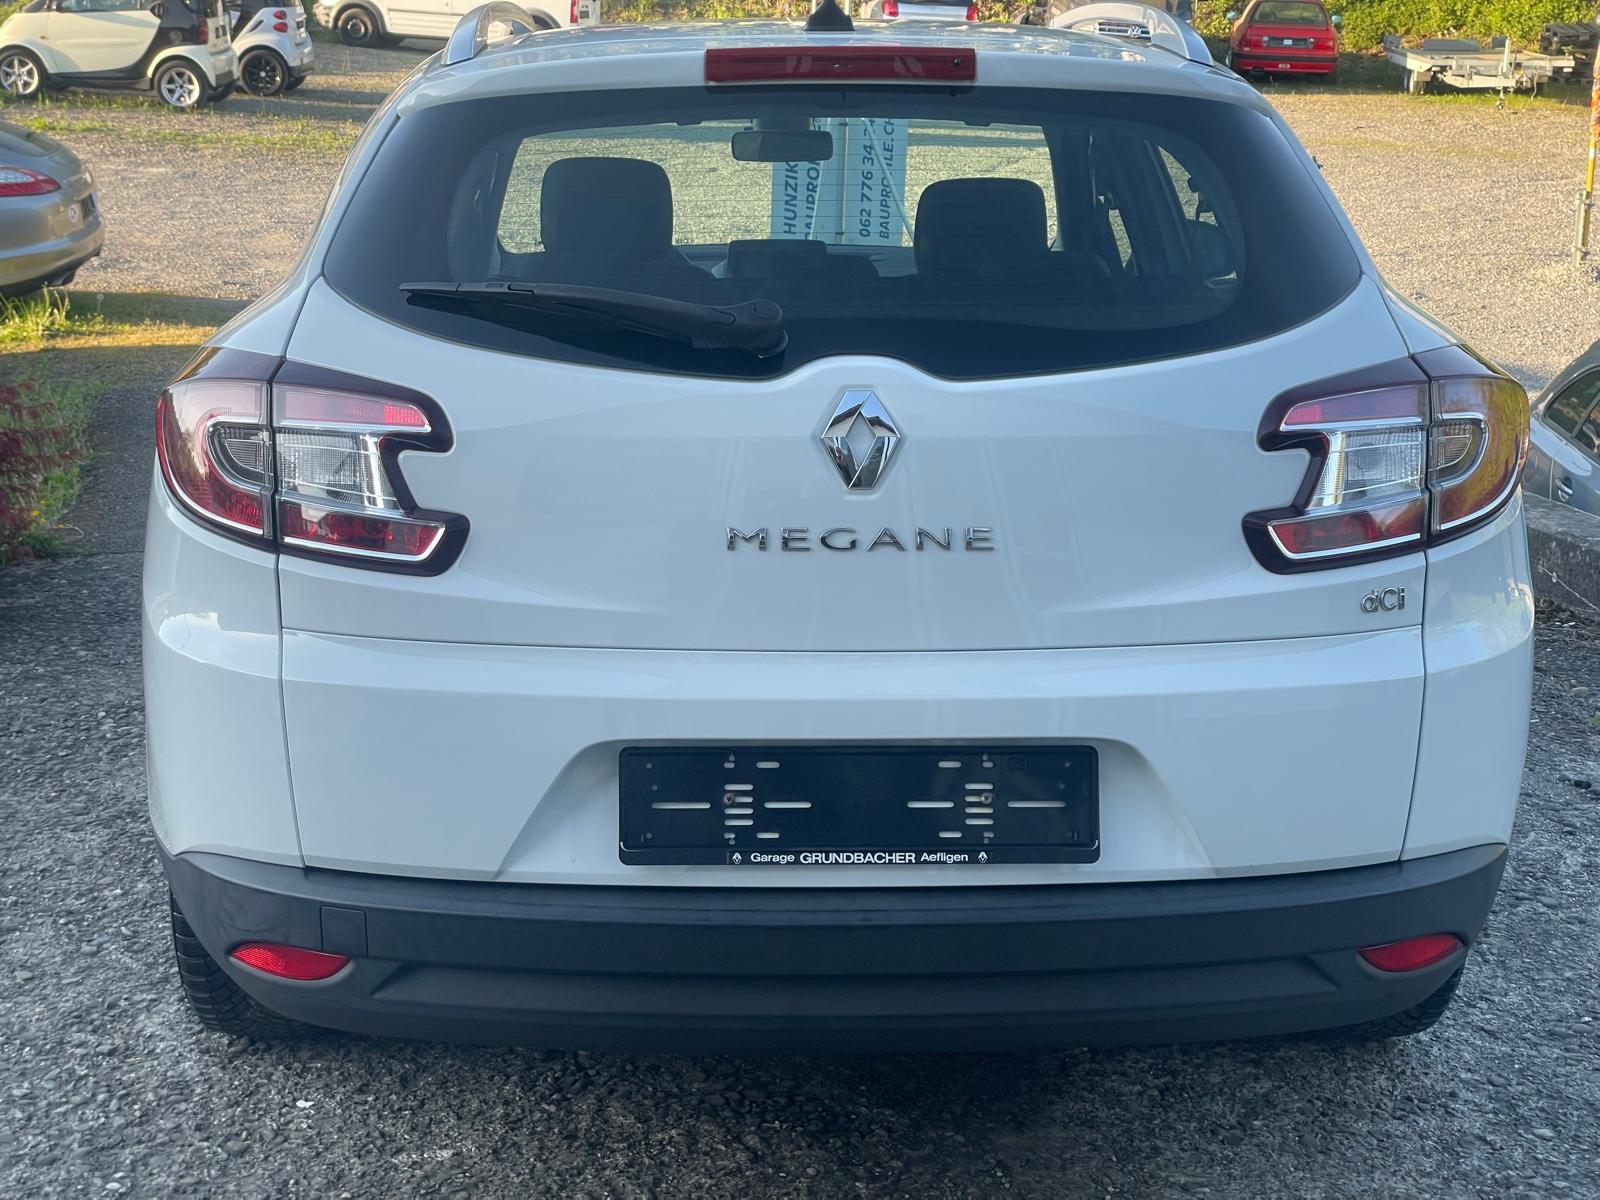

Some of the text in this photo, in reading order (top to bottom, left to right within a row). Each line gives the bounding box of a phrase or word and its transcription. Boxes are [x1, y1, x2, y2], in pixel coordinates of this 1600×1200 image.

[862, 144, 875, 168] 34
[861, 170, 874, 206] 776
[859, 208, 872, 238] 062
[726, 526, 994, 551] MEGANE
[1360, 587, 1405, 613] dCi
[750, 852, 969, 864] Garage GRUNDBACHER Aefligen
